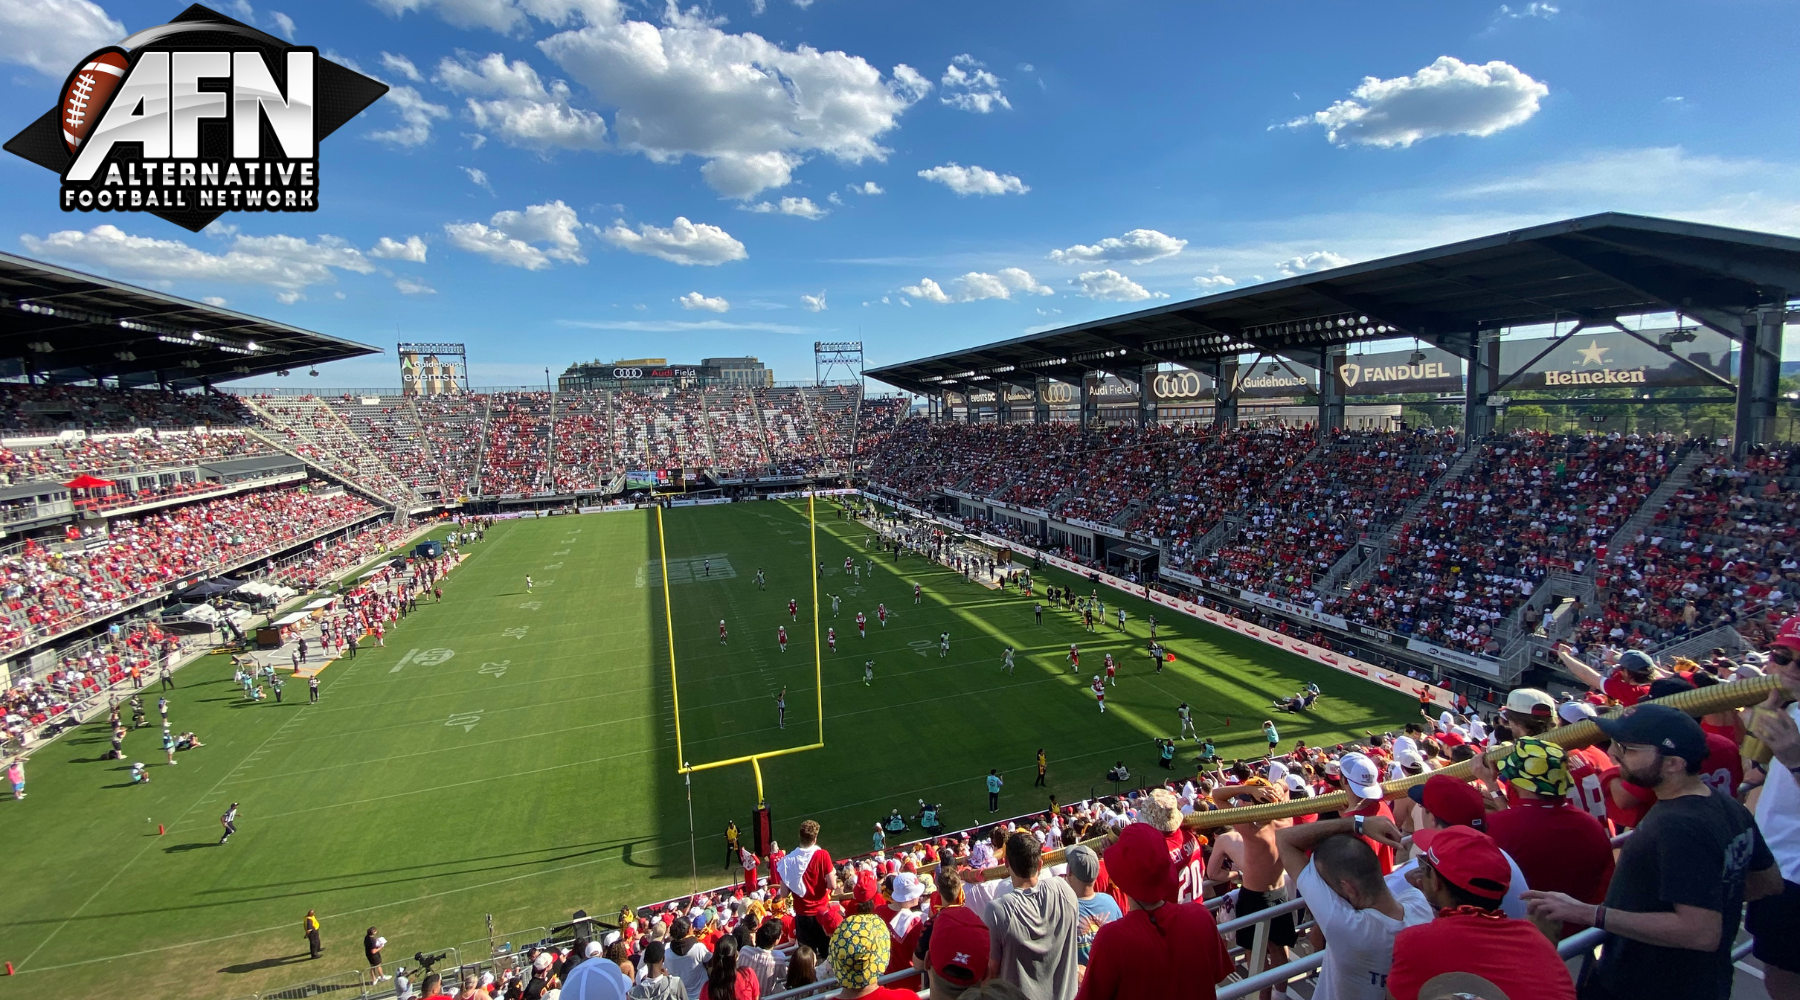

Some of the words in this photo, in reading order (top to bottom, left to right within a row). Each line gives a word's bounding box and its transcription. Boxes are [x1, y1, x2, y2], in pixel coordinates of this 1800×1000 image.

[651, 368, 672, 377] Audi
[674, 367, 696, 377] Field
[1364, 362, 1450, 382] FANDUEL
[1544, 368, 1646, 386] Heineken
[1089, 385, 1108, 396] Audi
[1109, 383, 1132, 395] Field
[1244, 375, 1307, 389] Guidehouse
[1178, 859, 1204, 905] 20
